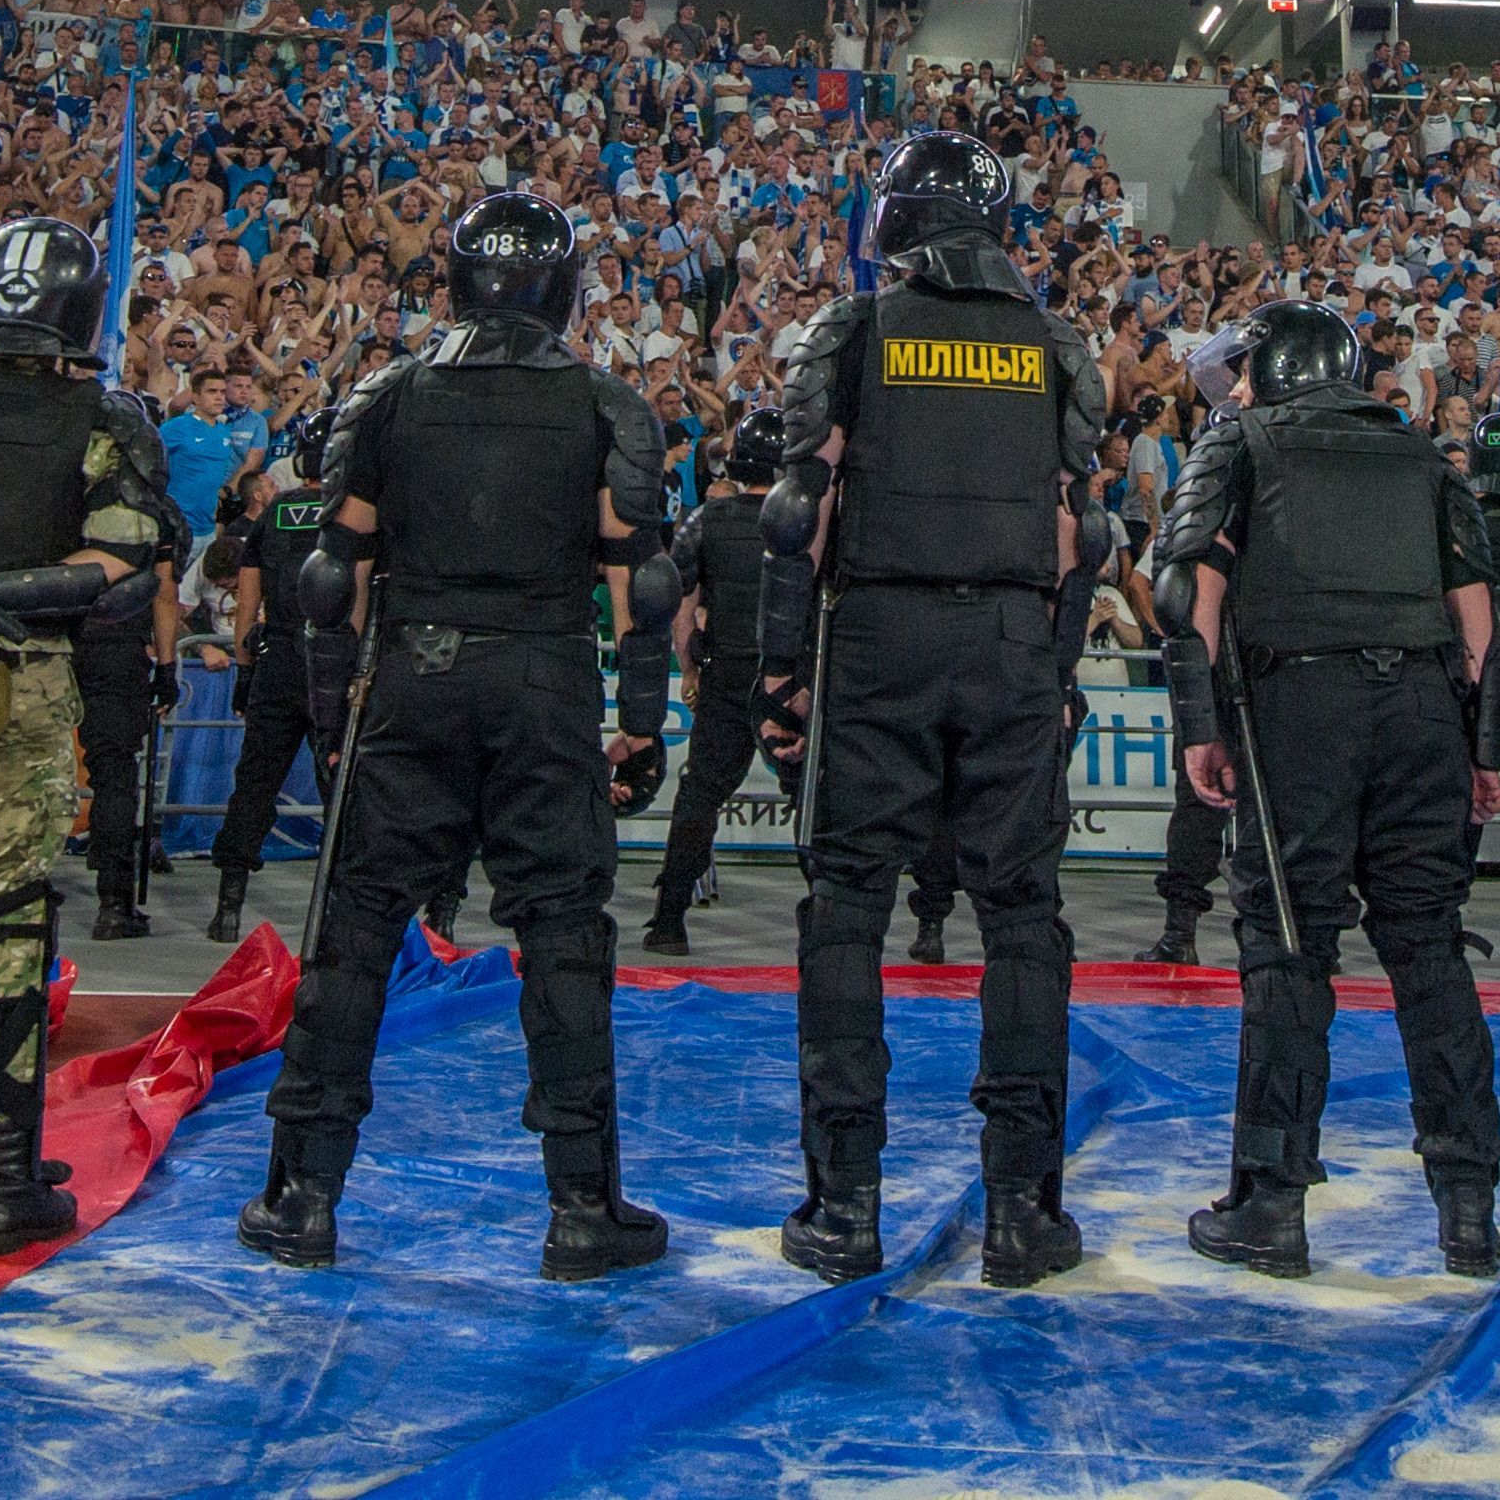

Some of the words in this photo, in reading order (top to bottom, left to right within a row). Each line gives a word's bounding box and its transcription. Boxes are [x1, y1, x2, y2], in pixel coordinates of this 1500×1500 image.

[971, 154, 998, 177] 80
[483, 233, 514, 256] 08
[888, 342, 1041, 384] МІЛІЦЫЯ
